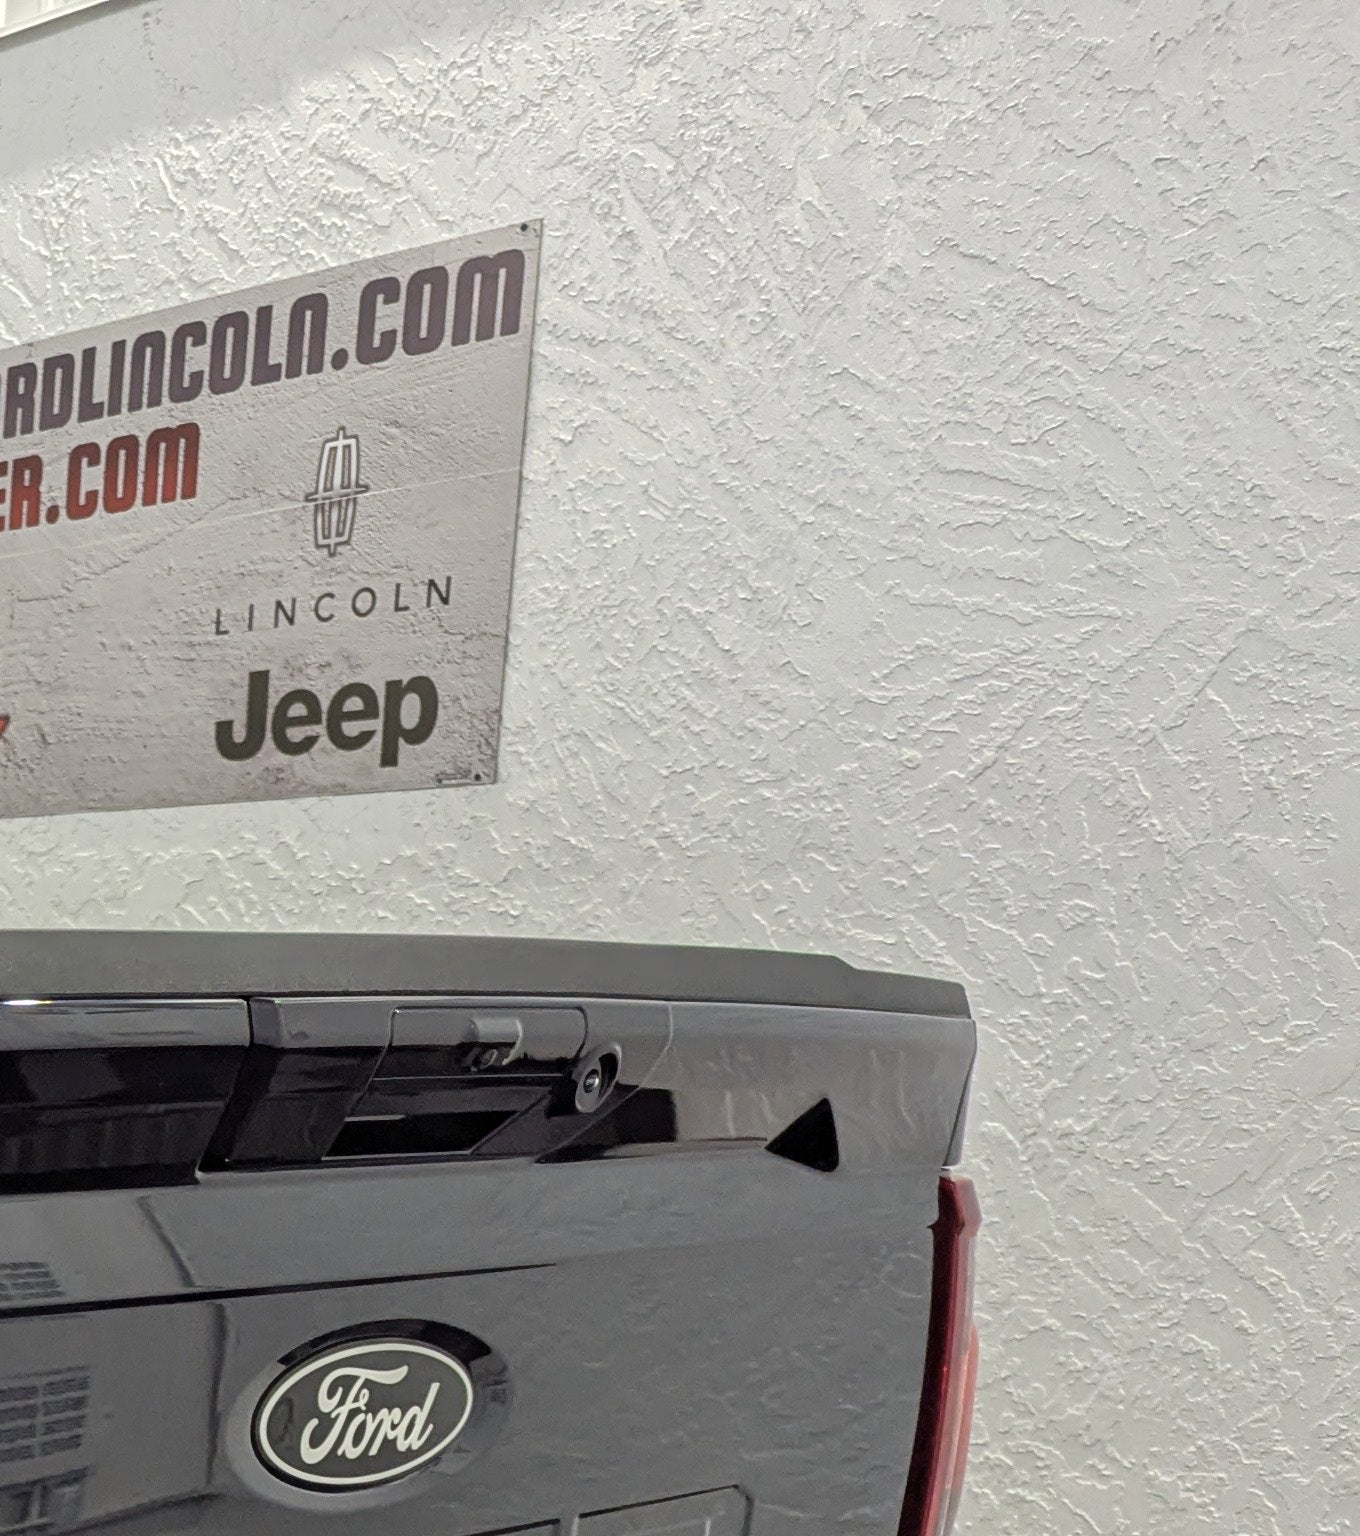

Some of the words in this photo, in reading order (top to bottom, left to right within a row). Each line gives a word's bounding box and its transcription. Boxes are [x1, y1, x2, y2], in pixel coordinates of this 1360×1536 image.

[213, 576, 452, 635] LINCOLN
[214, 669, 439, 768] Jeep
[300, 1365, 440, 1464] Ford
